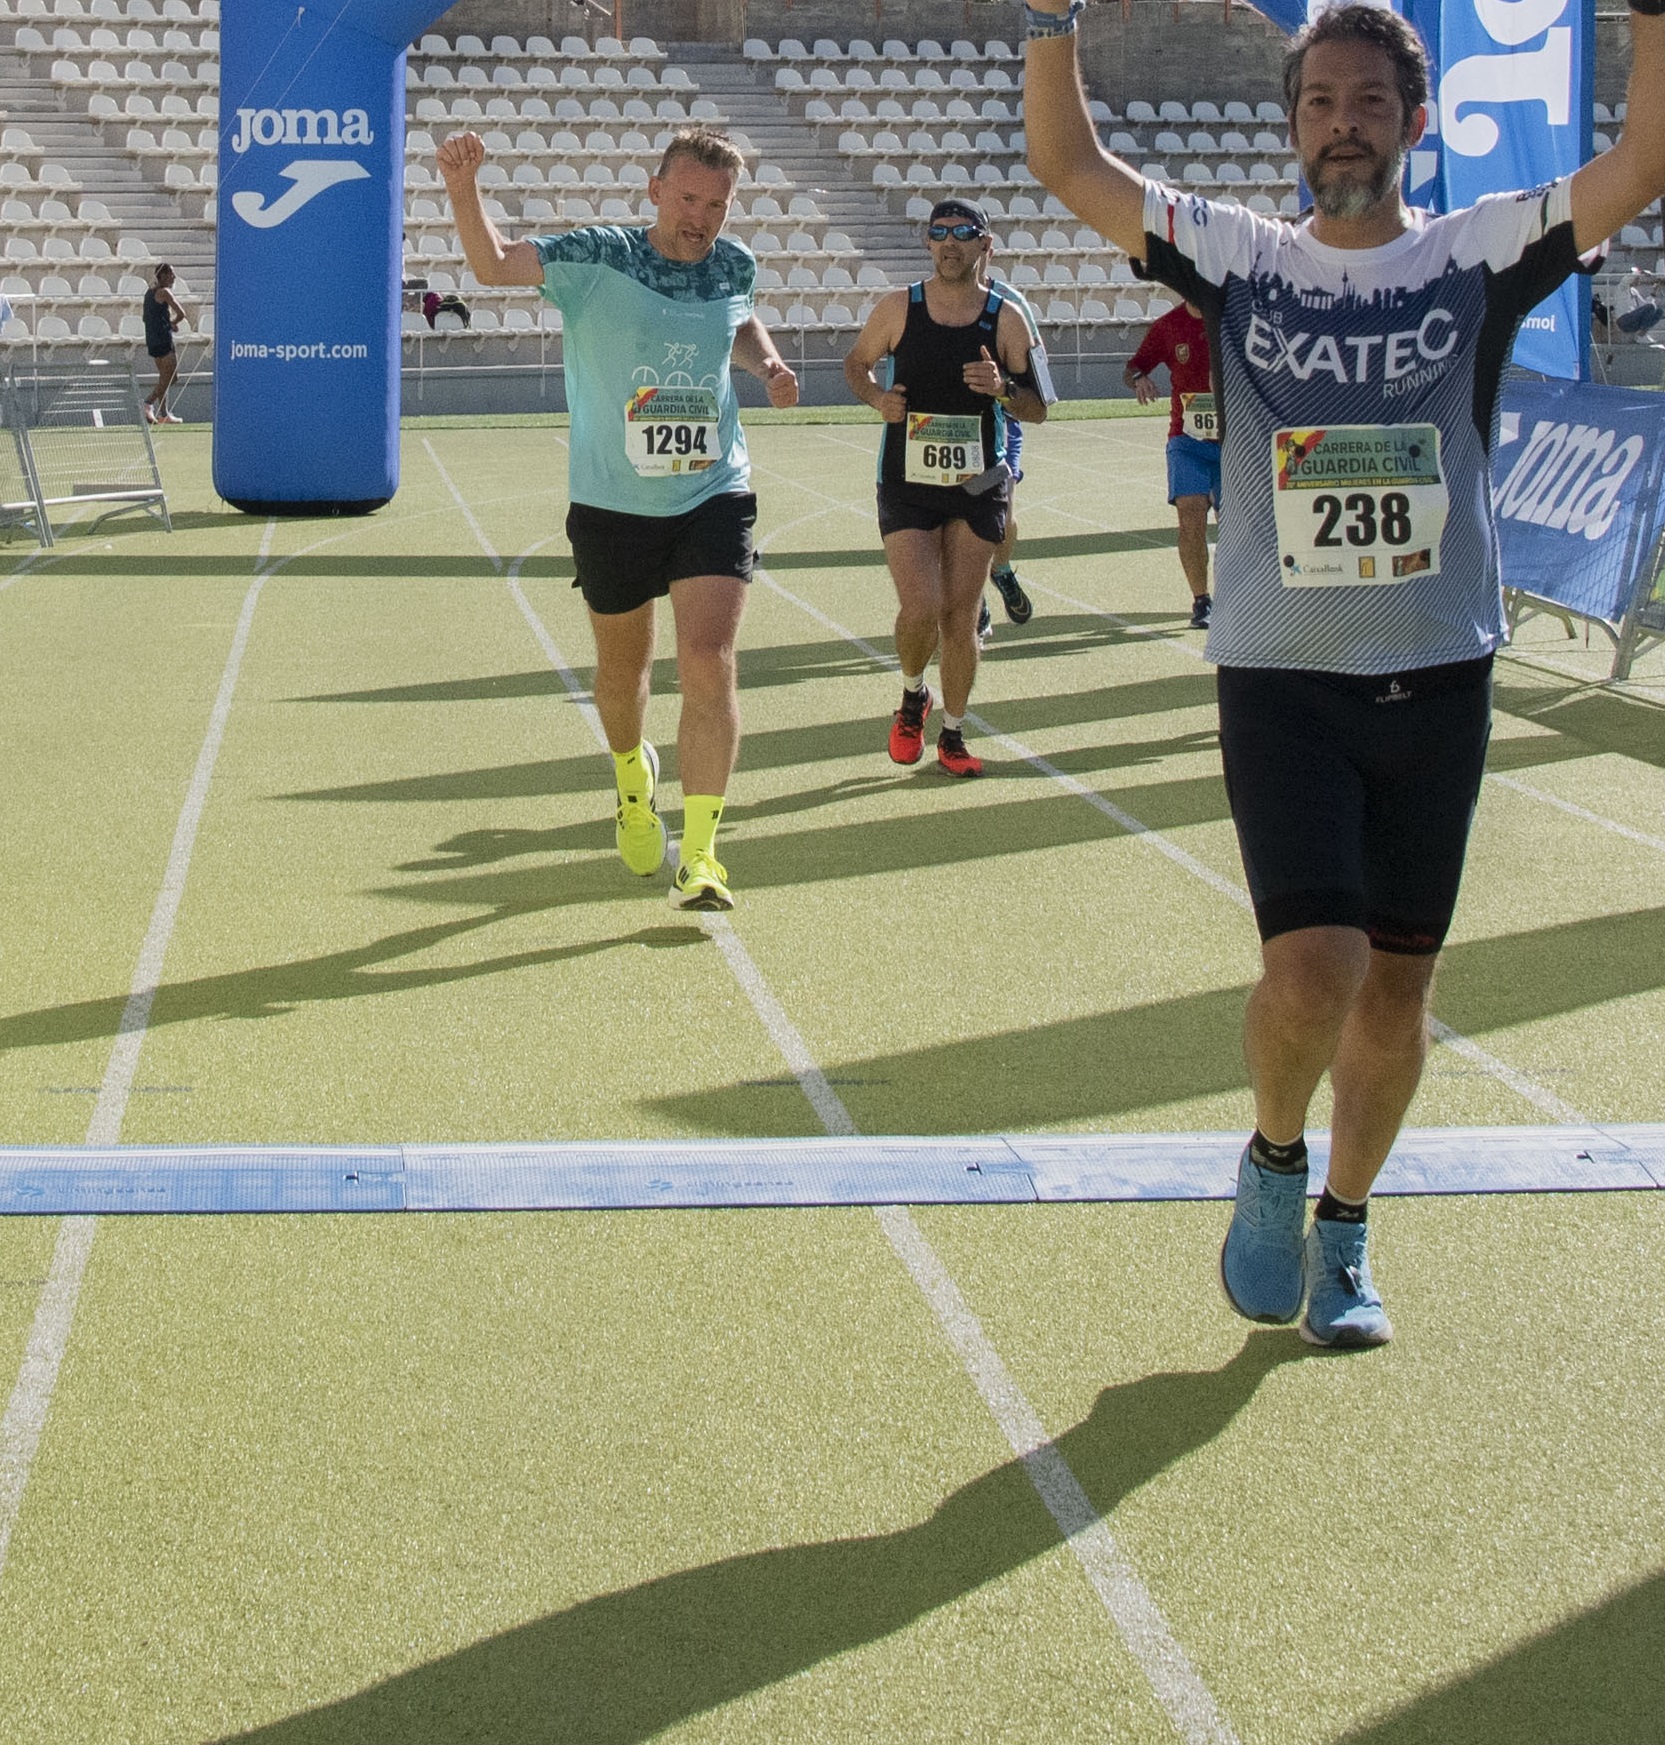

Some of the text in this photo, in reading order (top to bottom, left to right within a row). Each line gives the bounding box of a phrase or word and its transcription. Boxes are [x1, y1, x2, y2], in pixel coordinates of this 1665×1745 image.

[230, 339, 368, 361] joma-sport.com
[1245, 308, 1458, 384] EXATEC
[642, 404, 686, 415] GUARDIA
[642, 424, 708, 456] 1294
[1314, 440, 1407, 455] CARRERA DE LA
[923, 444, 967, 469] 689
[1301, 456, 1421, 475] GUARDIA CIVIL
[1312, 492, 1412, 547] 238
